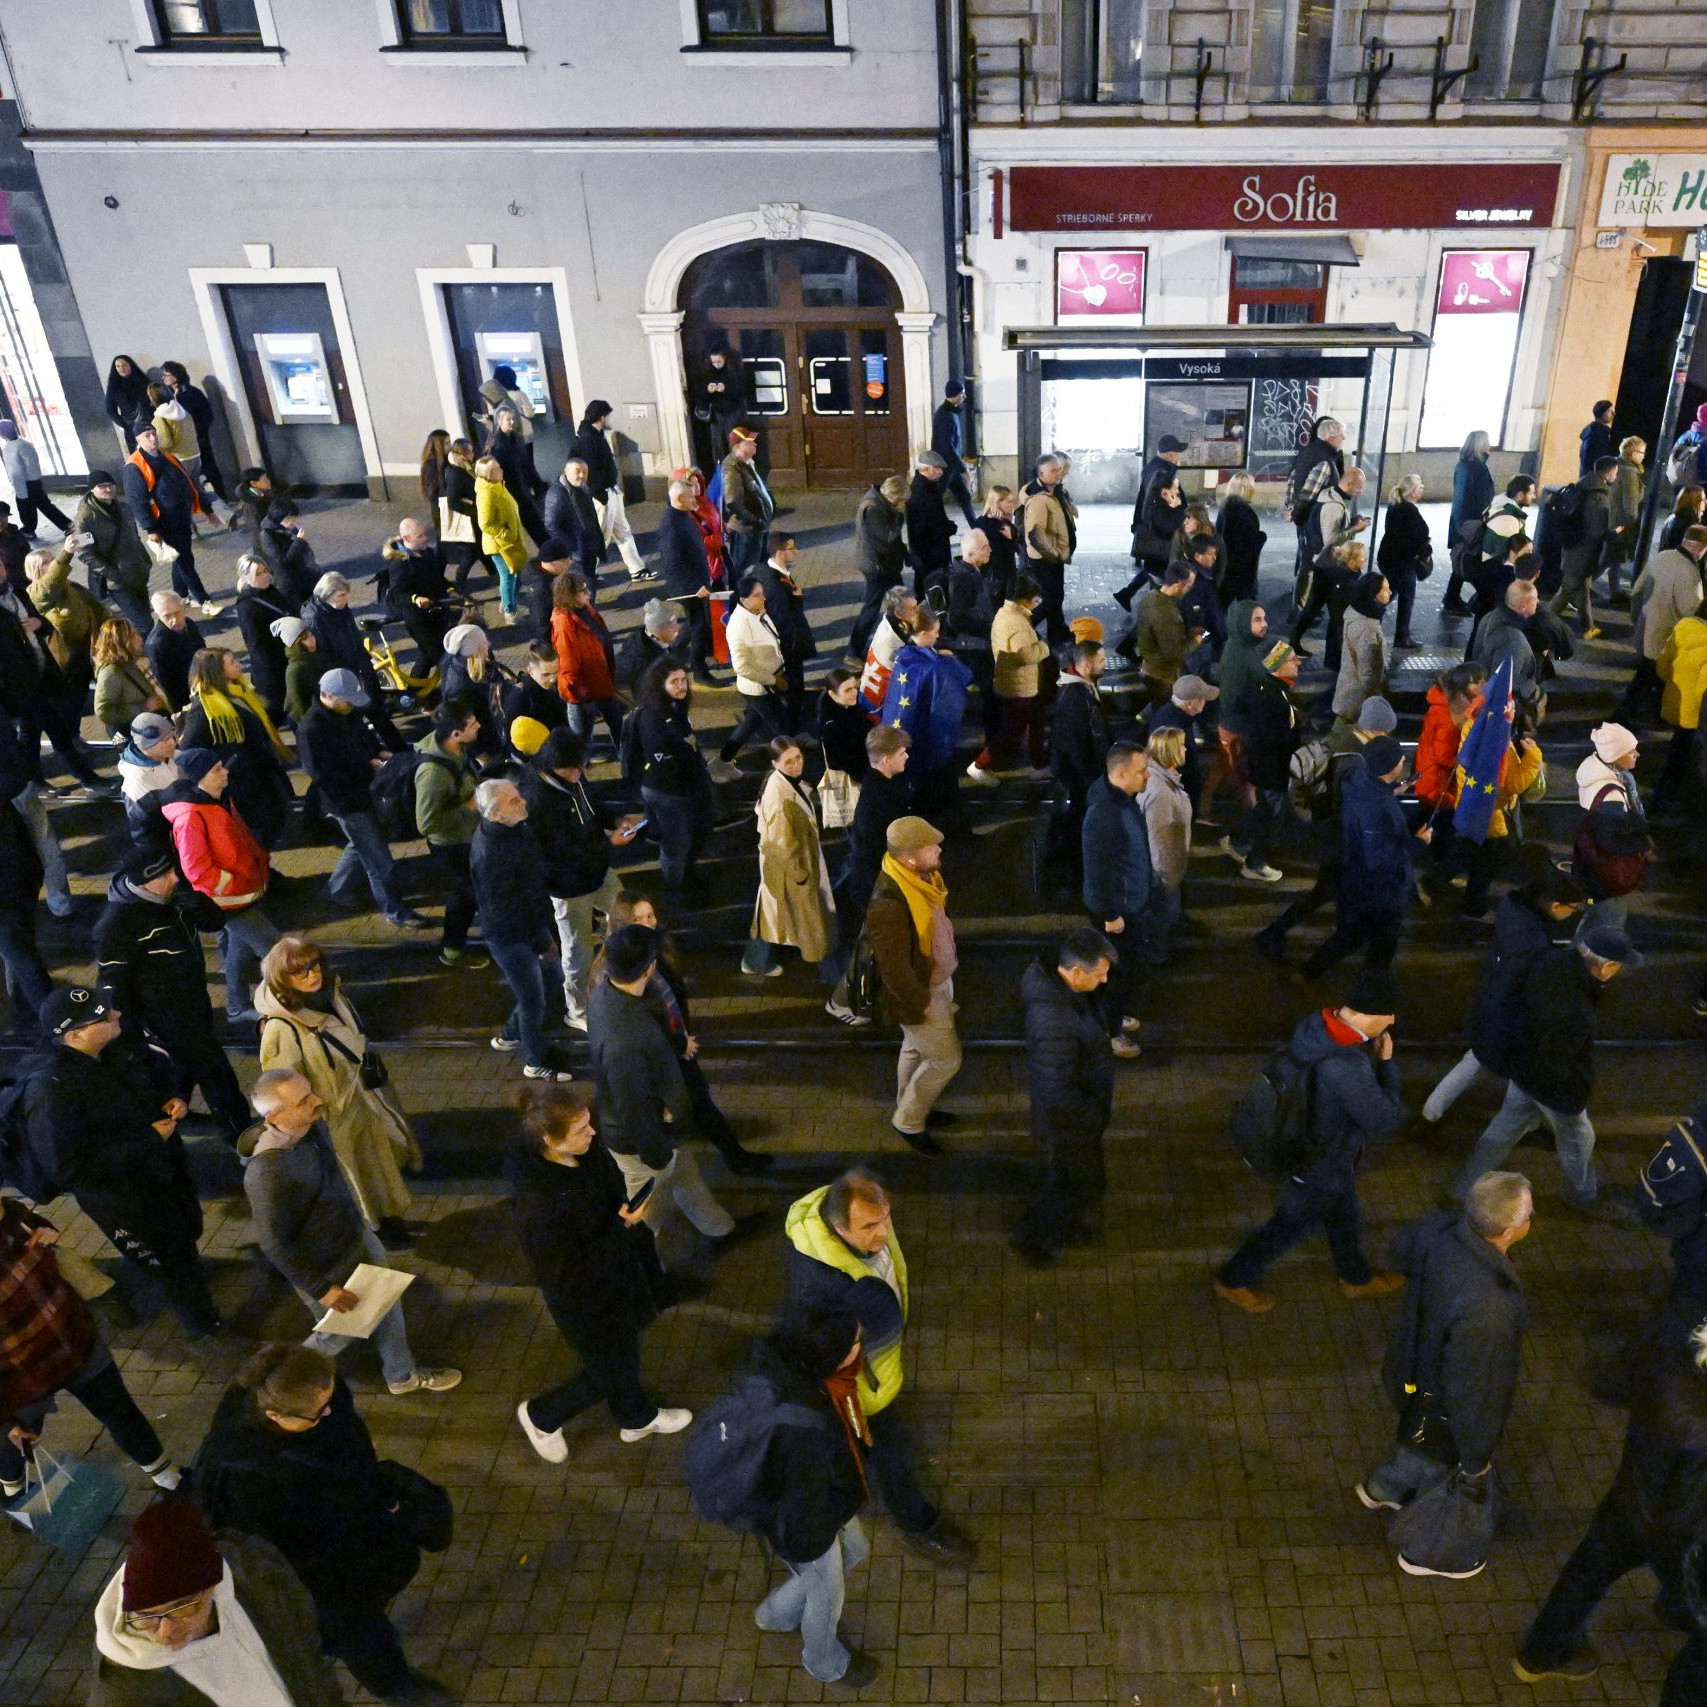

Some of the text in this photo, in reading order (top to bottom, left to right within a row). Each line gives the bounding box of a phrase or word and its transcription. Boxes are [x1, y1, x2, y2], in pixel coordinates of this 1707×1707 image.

[1233, 174, 1338, 222] Sofia
[1614, 200, 1663, 214] PARK
[1179, 362, 1221, 376] Vysoká
